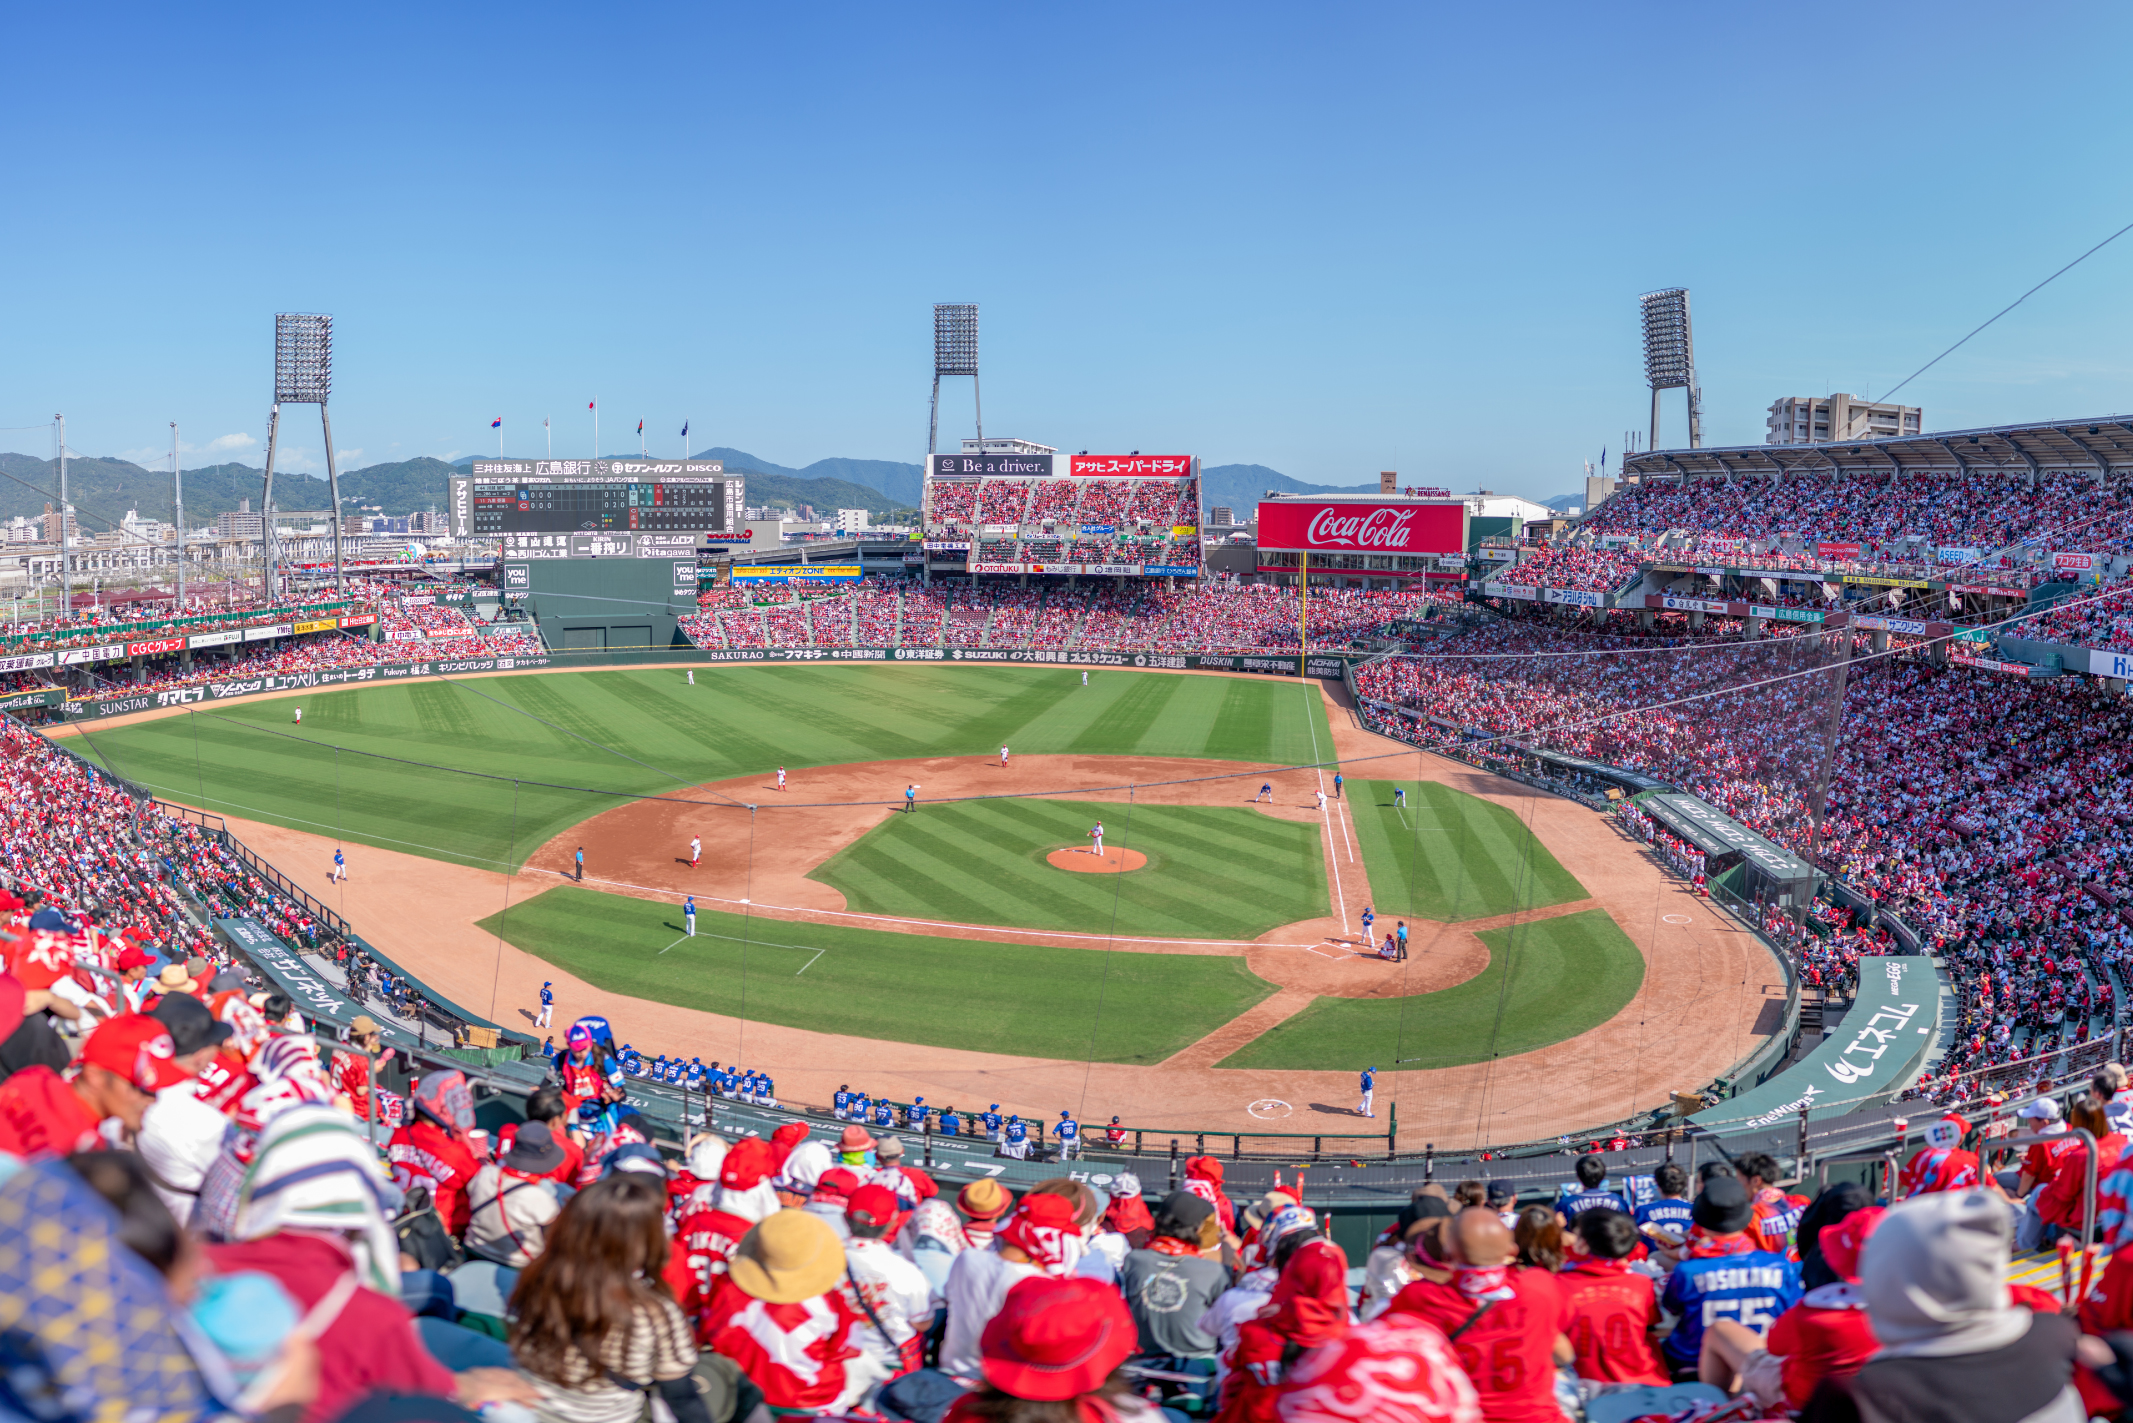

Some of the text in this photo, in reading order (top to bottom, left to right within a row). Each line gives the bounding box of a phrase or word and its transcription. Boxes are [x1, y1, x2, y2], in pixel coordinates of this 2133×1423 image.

[474, 463, 532, 473] 三井住友海上
[536, 461, 591, 475] 広島銀行
[963, 459, 1045, 472] Be a driver.
[1076, 460, 1186, 472] アサヒスーパードライ
[456, 480, 468, 536] アサヒビール
[725, 480, 734, 533] 広島市信用組合
[1308, 508, 1418, 547] Coca-Cola
[671, 536, 695, 544] ムロオ
[518, 549, 568, 558] 西川ゴム工業
[578, 542, 626, 554] 一番搾り
[1939, 550, 1963, 560] ASEED
[2057, 556, 2089, 567] フコク生命
[507, 570, 525, 578] you
[677, 566, 693, 575] you
[1562, 591, 1597, 605] アヲハタ ジャム
[1779, 609, 1820, 622] 広島信用金庫
[1889, 620, 1925, 634] サニクリーン
[131, 638, 182, 655] CGCグループ
[82, 647, 120, 661] 中国電力
[711, 652, 764, 660] SAKURAO
[784, 650, 828, 659] フマキラー
[906, 649, 944, 659] 東洋証券
[1023, 651, 1068, 662] 大和興産
[438, 661, 493, 671] キリンビバレッジ
[1148, 656, 1186, 669] 五洋建設
[1200, 657, 1234, 666] DUSKIN
[1307, 659, 1341, 667] NOHMI
[322, 669, 376, 682] 住まいのトータテ
[384, 668, 407, 676] Fukuya
[410, 664, 430, 675] 福屋
[1307, 667, 1340, 676] 能美防災
[278, 675, 319, 689] ユウベル
[157, 687, 204, 706] クマヒラ
[100, 698, 149, 715] SUNSTAR
[271, 958, 345, 1014] サンネット
[1746, 1096, 1814, 1129] EneWings
[1649, 1207, 1693, 1220] OHSHIM
